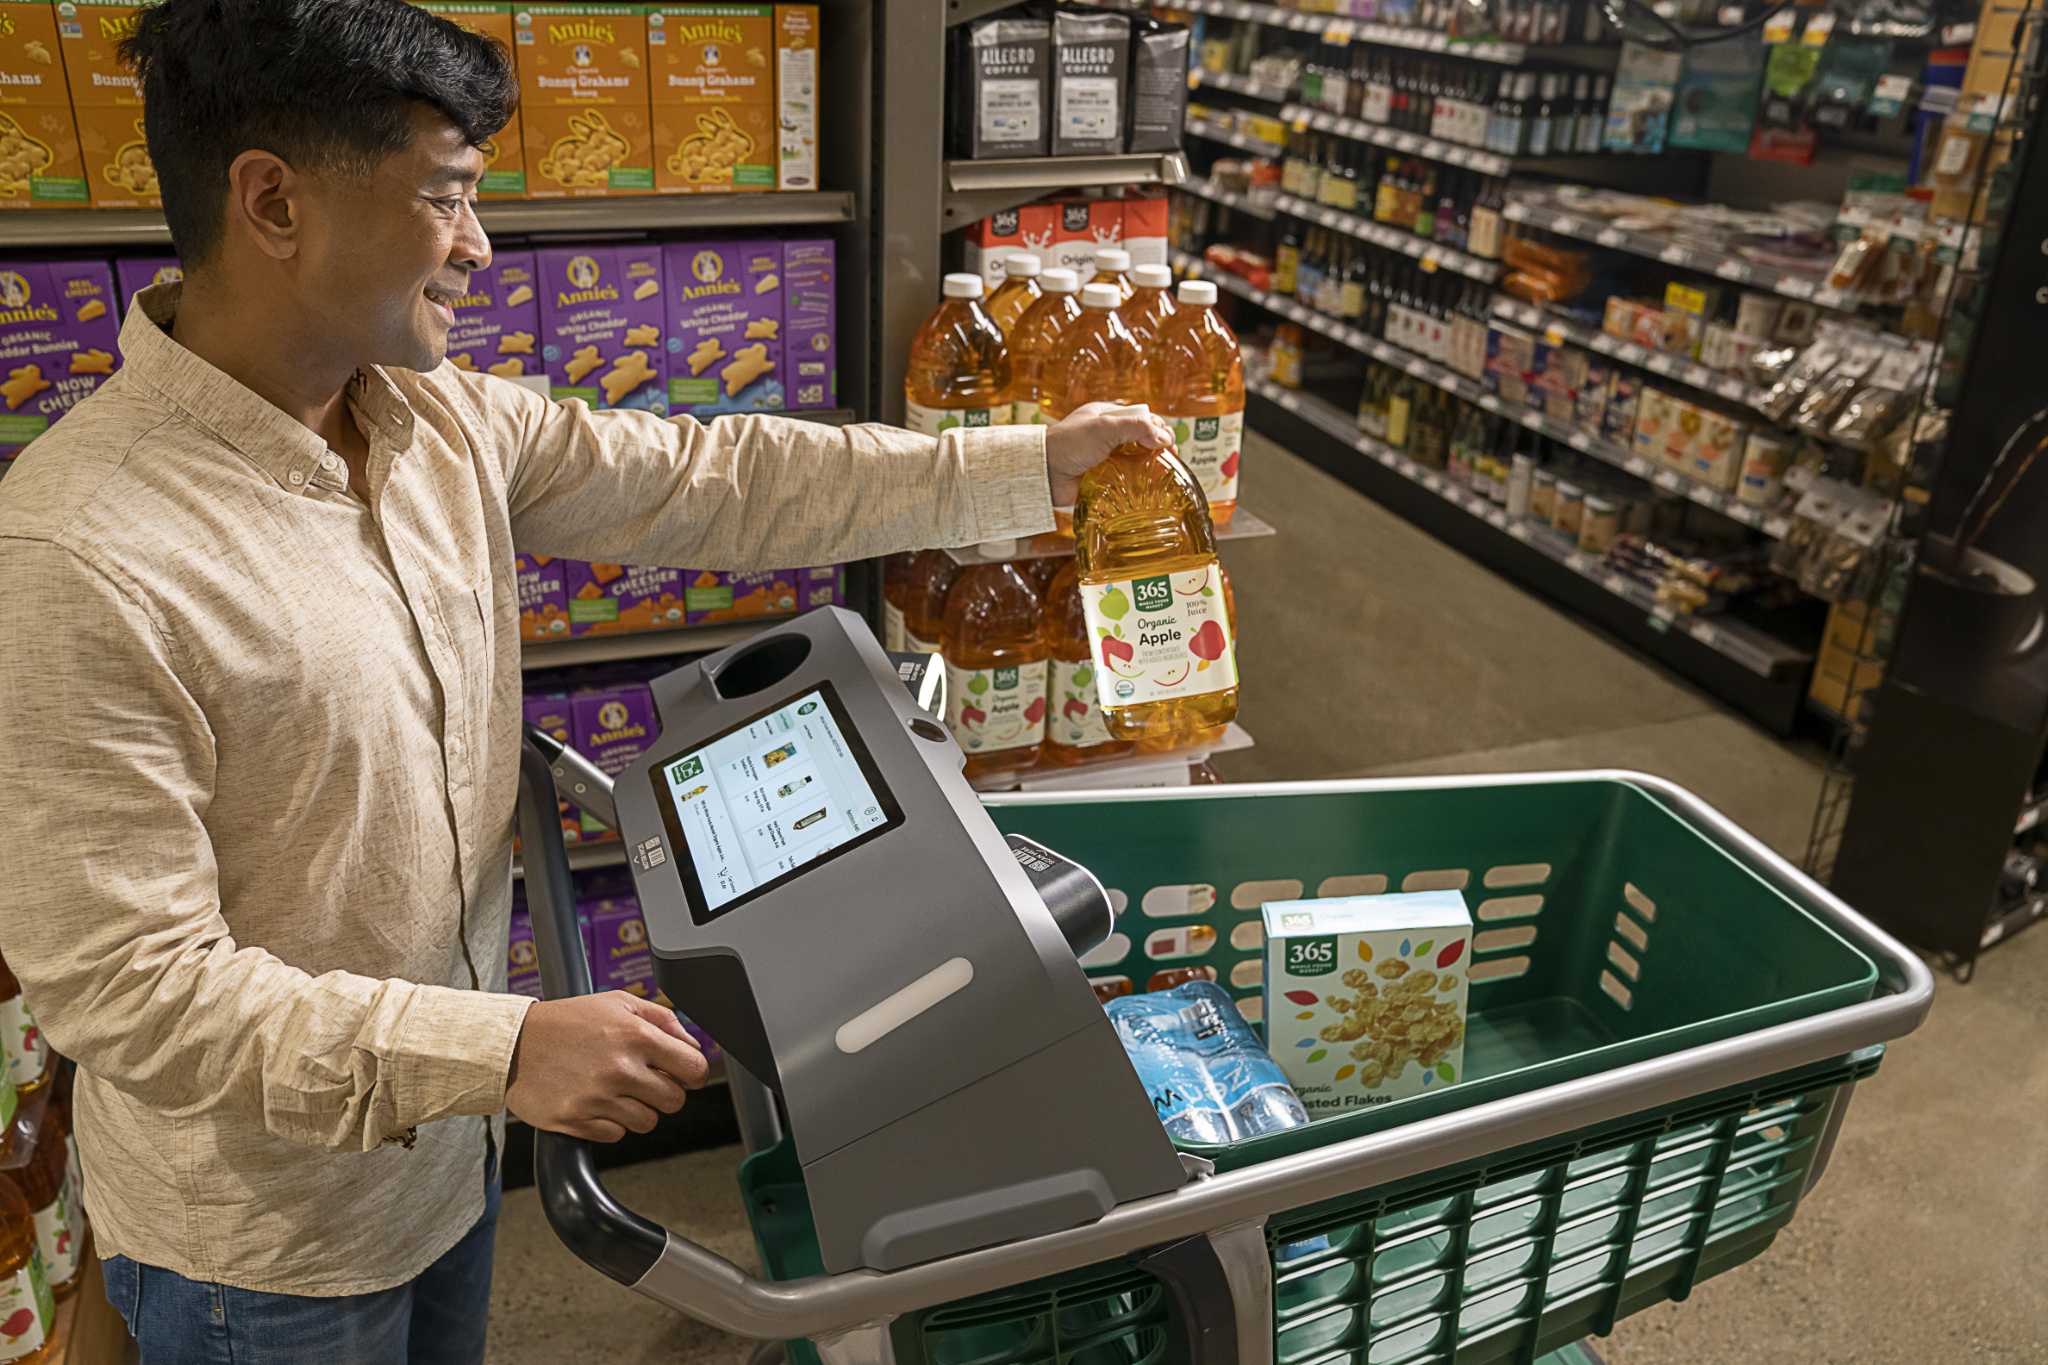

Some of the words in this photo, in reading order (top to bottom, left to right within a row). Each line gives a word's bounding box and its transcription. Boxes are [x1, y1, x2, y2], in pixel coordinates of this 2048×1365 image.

[548, 19, 615, 44] Annie's
[680, 19, 743, 44] Annie's
[981, 47, 1035, 65] ALLEGRO
[1061, 47, 1115, 64] ALLEGRO
[0, 72, 42, 86] hams
[558, 283, 619, 309] Annie's
[681, 278, 742, 302] Annie's
[0, 303, 58, 325] nnie's
[56, 376, 95, 393] NOW
[1137, 581, 1169, 601] 365
[1137, 615, 1177, 631] Organic
[1139, 629, 1182, 647] Apple
[991, 703, 1019, 714] Apple
[1290, 942, 1333, 963] 365
[1294, 1083, 1332, 1097] rganic
[1345, 1094, 1392, 1107] Flakes
